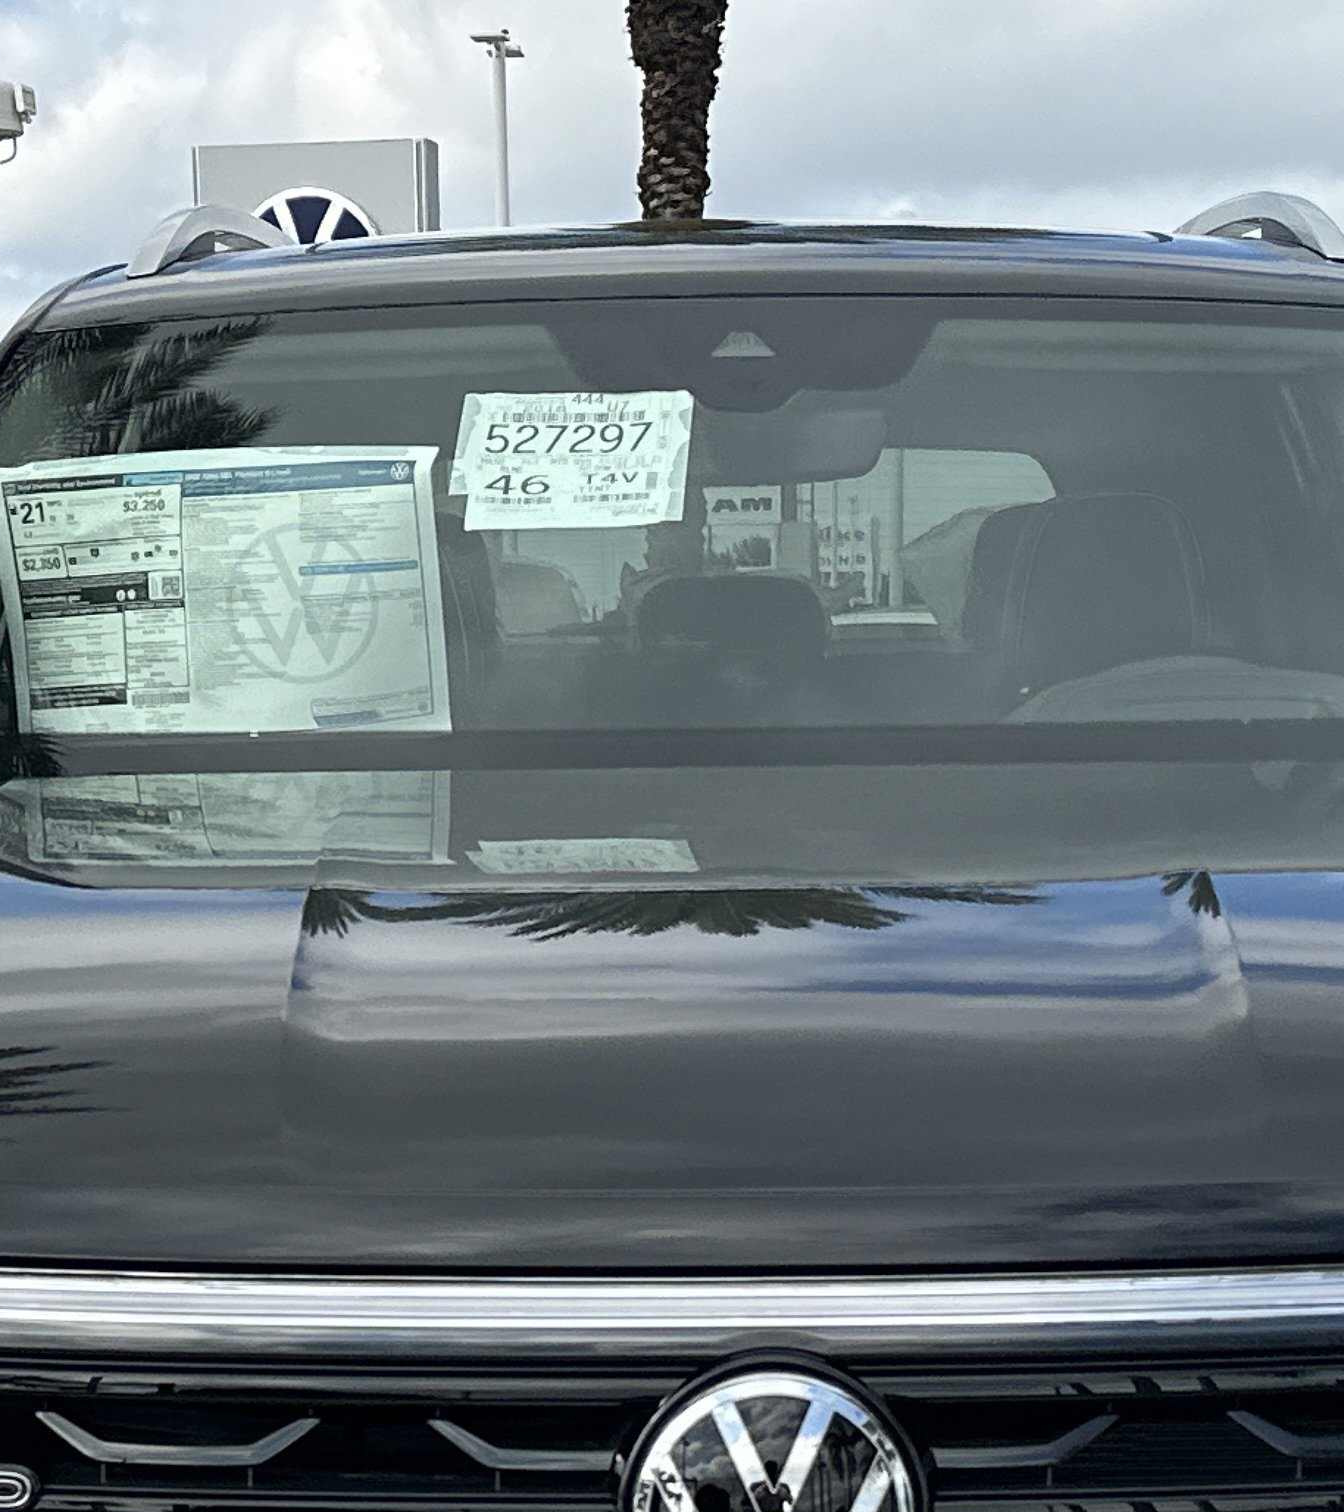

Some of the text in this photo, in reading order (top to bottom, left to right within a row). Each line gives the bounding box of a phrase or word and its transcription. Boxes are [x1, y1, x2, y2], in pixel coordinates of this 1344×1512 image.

[484, 421, 654, 454] 527297
[484, 473, 551, 496] 46
[19, 501, 45, 525] 21
